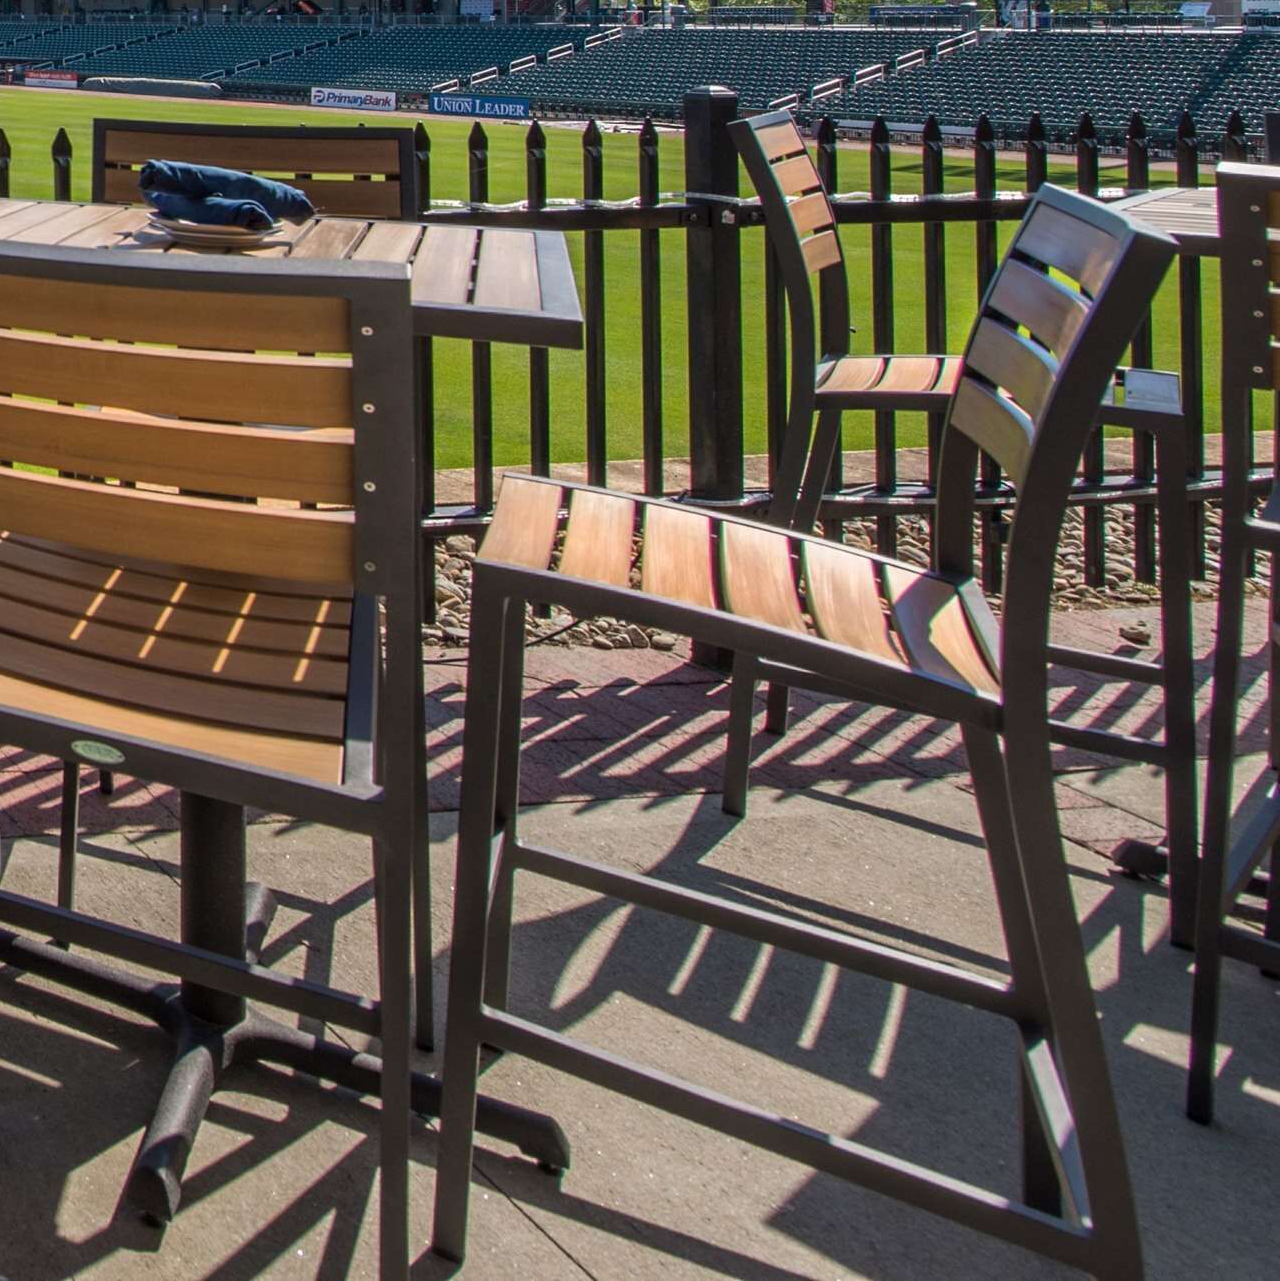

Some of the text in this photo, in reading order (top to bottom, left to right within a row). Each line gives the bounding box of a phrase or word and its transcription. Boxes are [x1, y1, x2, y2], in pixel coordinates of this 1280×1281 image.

[325, 92, 392, 107] PrimaryBank
[433, 97, 525, 116] UNION LEADER
